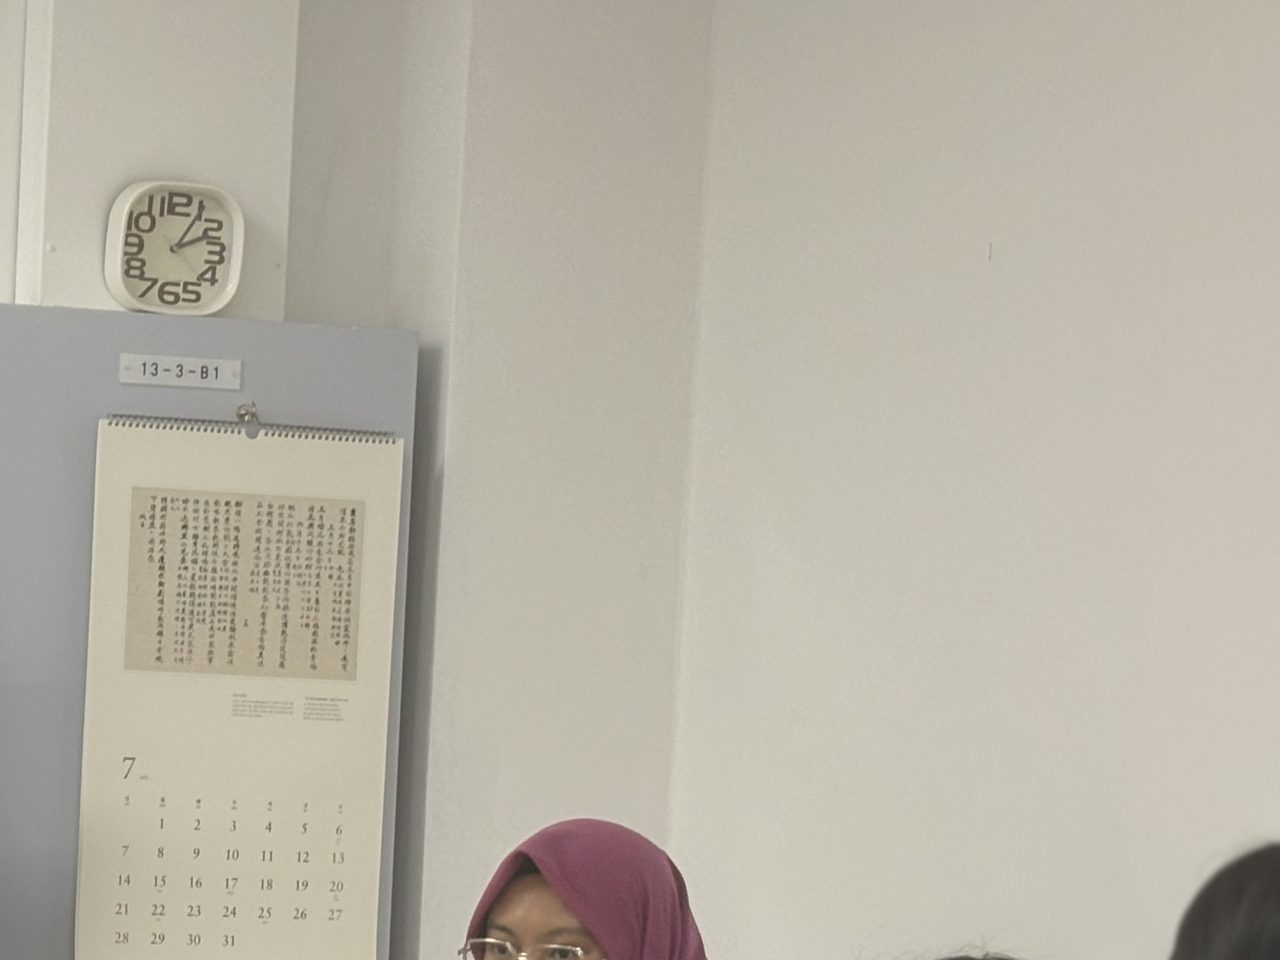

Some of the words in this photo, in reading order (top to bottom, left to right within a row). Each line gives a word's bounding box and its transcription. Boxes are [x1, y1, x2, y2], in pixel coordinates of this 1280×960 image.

[148, 194, 166, 218] 11
[167, 192, 194, 218] 12
[126, 209, 157, 234] 10
[202, 217, 224, 241] 2
[123, 232, 145, 257] 9
[204, 240, 227, 266] 3
[123, 257, 147, 280] 8
[196, 265, 219, 287] 4
[137, 276, 159, 299] 7
[157, 281, 182, 306] 6
[181, 280, 203, 304] 5
[142, 362, 218, 380] 13-3-B1
[122, 757, 137, 780] 7
[193, 818, 201, 832] 2
[230, 819, 237, 833] 3
[265, 821, 272, 833] 4
[300, 822, 309, 835] 5
[335, 824, 343, 836] 6
[121, 844, 130, 857] 7
[156, 846, 165, 859] 8
[192, 847, 201, 860] 9
[226, 848, 240, 861] 10
[261, 850, 273, 863] 11
[297, 850, 310, 864] 12
[332, 851, 345, 865] 13
[118, 874, 131, 887] 14
[153, 875, 167, 888] 15
[190, 876, 203, 889] 16
[225, 877, 239, 890] 17
[260, 878, 274, 891] 18
[295, 879, 309, 892] 19
[328, 880, 344, 893] 20
[114, 902, 129, 916] 21
[151, 903, 166, 917] 22
[186, 904, 202, 918] 23
[222, 905, 237, 918] 24
[257, 906, 273, 920] 25
[292, 907, 308, 921] 26
[327, 908, 344, 922] 27
[114, 931, 130, 945] 28
[150, 932, 166, 945] 29
[186, 933, 202, 946] 30
[222, 934, 235, 948] 31
